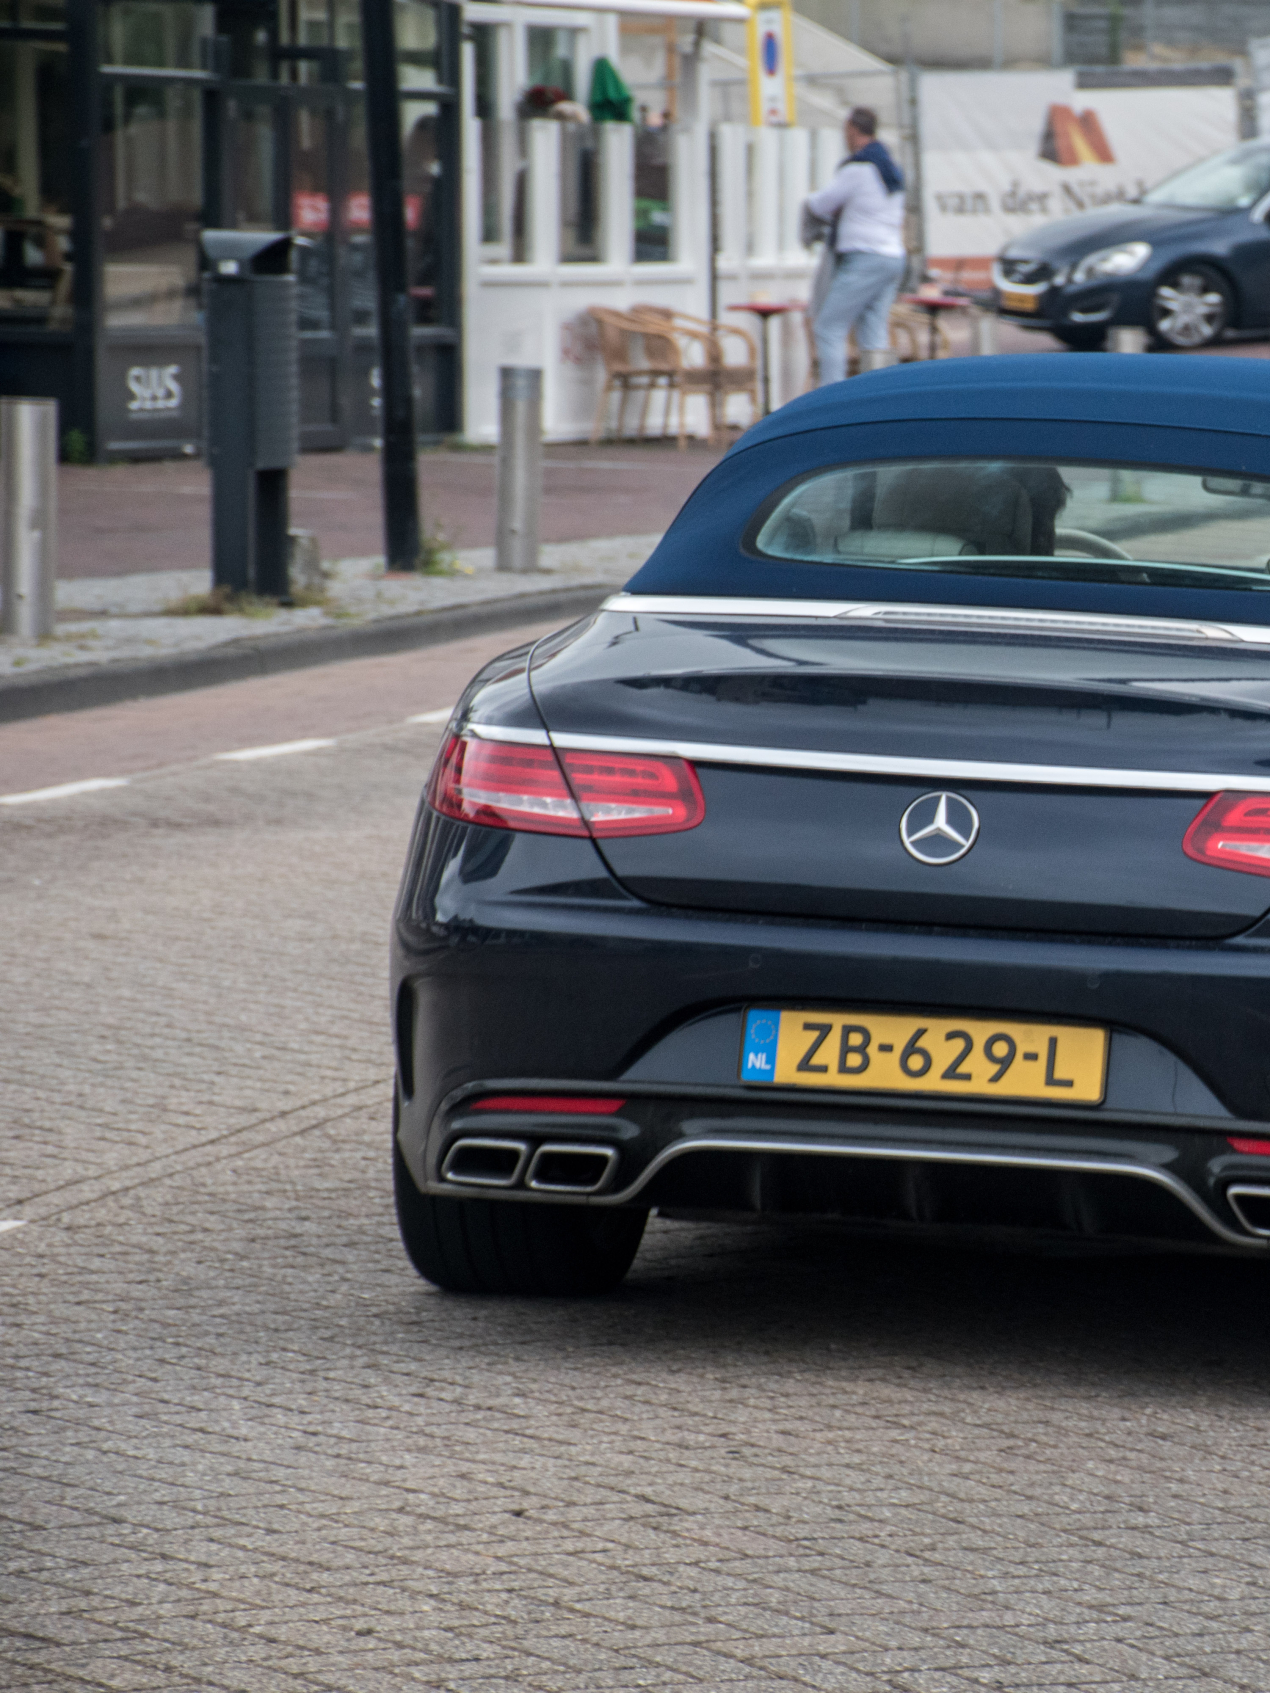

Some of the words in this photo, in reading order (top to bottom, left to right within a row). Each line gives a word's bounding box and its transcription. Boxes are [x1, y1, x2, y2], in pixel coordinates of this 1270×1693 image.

[934, 190, 991, 216] van
[1002, 179, 1050, 215] der
[747, 1051, 772, 1071] NL
[796, 1022, 1074, 1088] ZB-629-L
